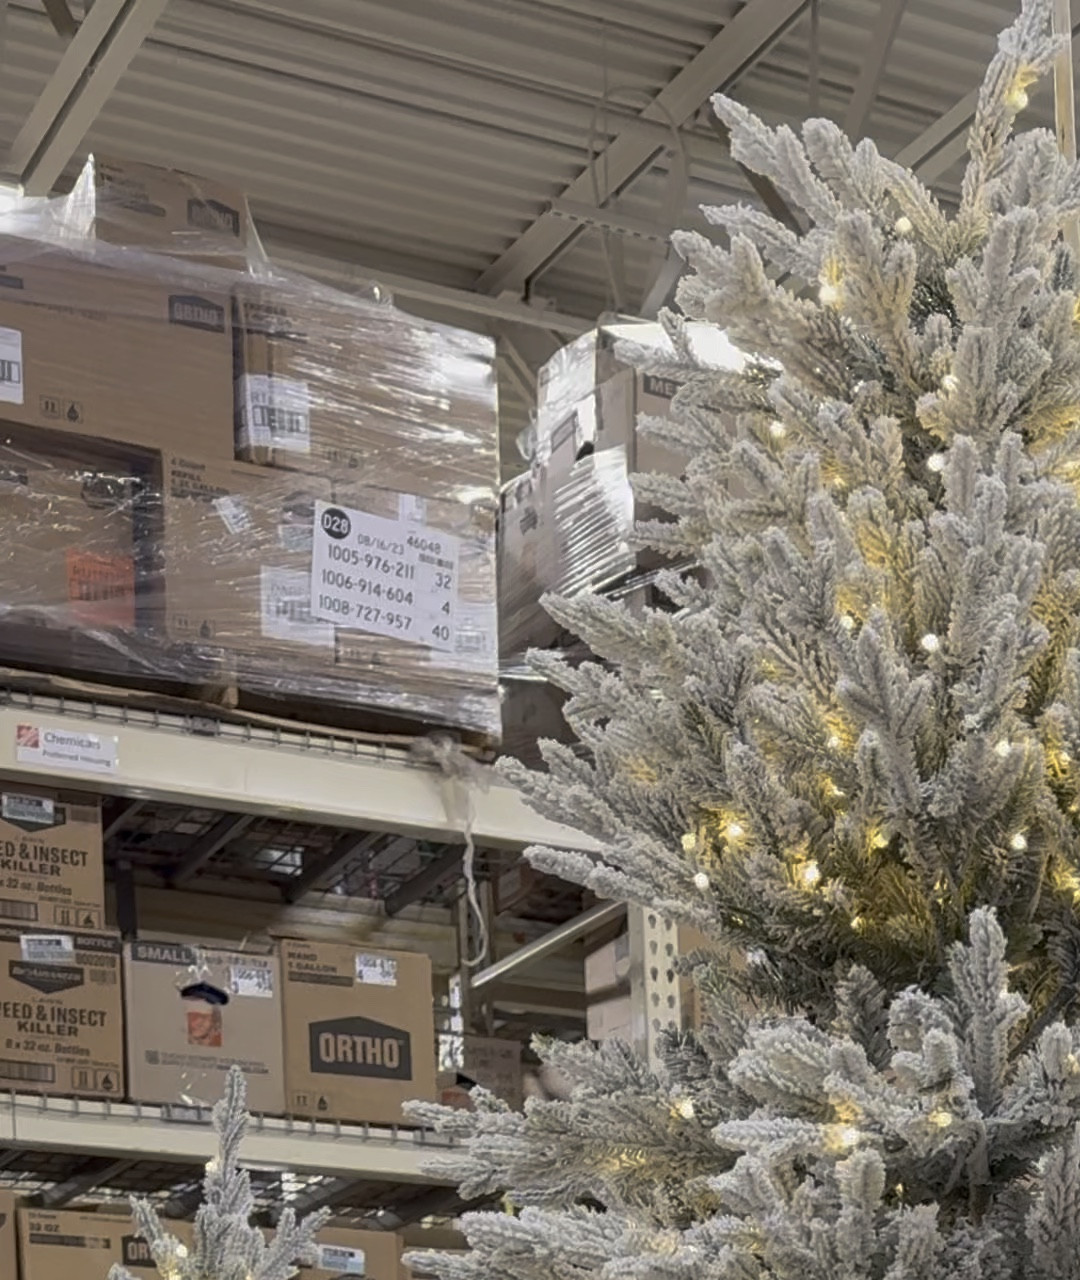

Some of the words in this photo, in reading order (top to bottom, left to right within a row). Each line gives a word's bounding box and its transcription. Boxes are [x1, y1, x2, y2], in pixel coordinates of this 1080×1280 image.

[323, 514, 349, 535] D28
[328, 543, 415, 580] 1005-976-211
[435, 572, 452, 590] 32
[321, 568, 414, 606] 1006-914-604
[441, 601, 450, 615] 4
[319, 594, 412, 631] 1008-727-957
[432, 624, 450, 641] 40
[19, 842, 29, 860] &
[32, 845, 88, 867] INSECT
[1, 859, 61, 877] KILLER
[136, 946, 191, 963] SMALL
[0, 1001, 32, 1019] EED
[36, 1004, 47, 1021] &
[51, 1006, 107, 1027] INSECT
[17, 1020, 79, 1038] KILLER
[23, 1039, 36, 1051] 32
[54, 1043, 90, 1057] Bottles
[319, 1032, 399, 1069] ORTHO
